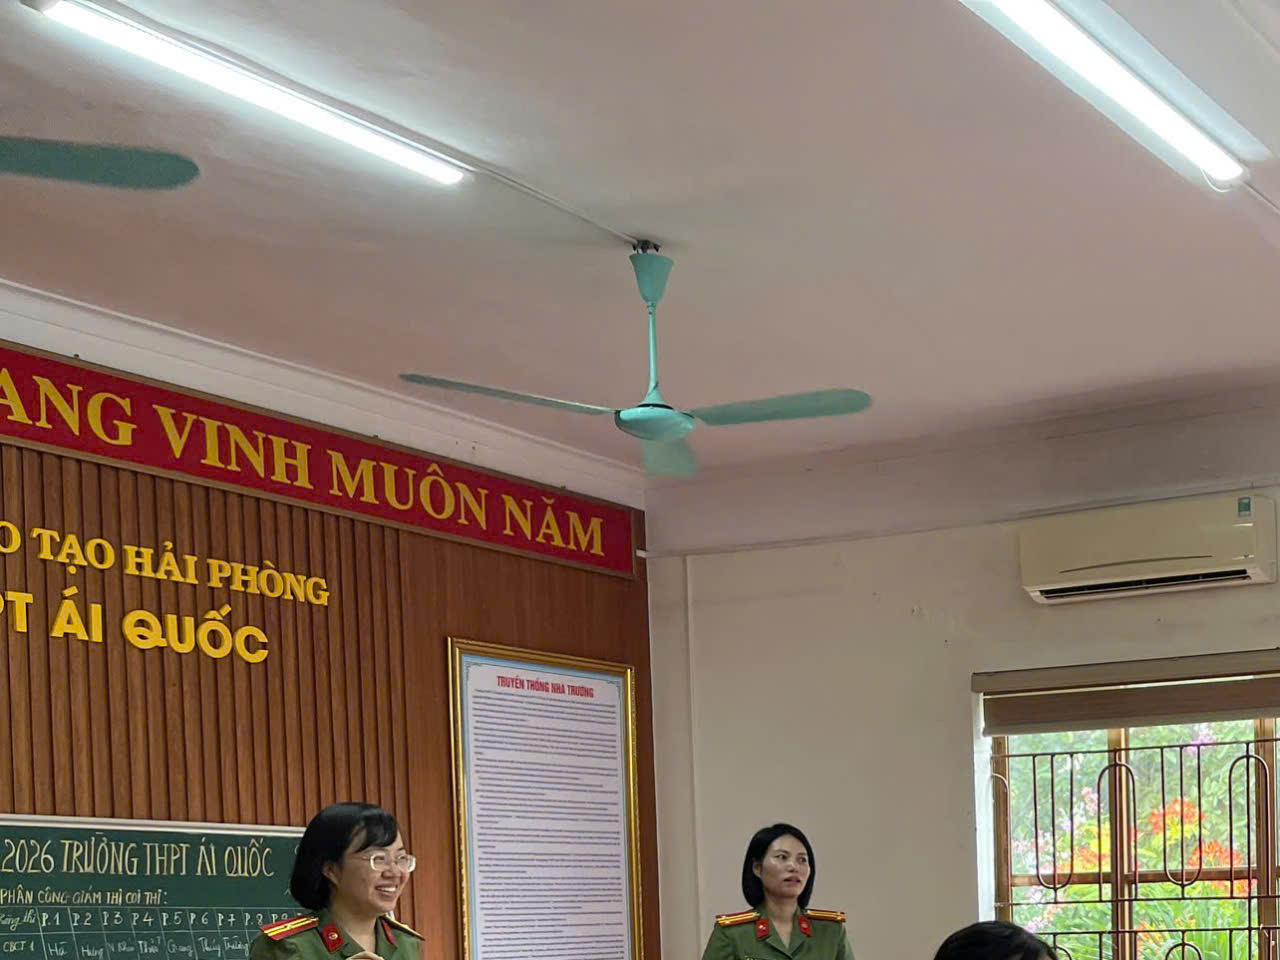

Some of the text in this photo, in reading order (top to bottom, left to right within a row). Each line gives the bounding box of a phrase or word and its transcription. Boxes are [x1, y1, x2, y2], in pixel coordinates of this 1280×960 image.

[152, 404, 314, 488] VINH
[327, 450, 489, 530] MUÔN
[501, 494, 605, 556] NĂM
[31, 528, 115, 575] TẠO
[123, 541, 199, 584] HẢI
[207, 560, 329, 606] PHÒNG
[0, 585, 269, 663] T ÁI QUỐC
[1, 832, 274, 877] 2026 TRƯỜNG THPT ÁI QUỐC
[0, 884, 33, 905] PHÂN
[38, 886, 68, 904] CÔNG
